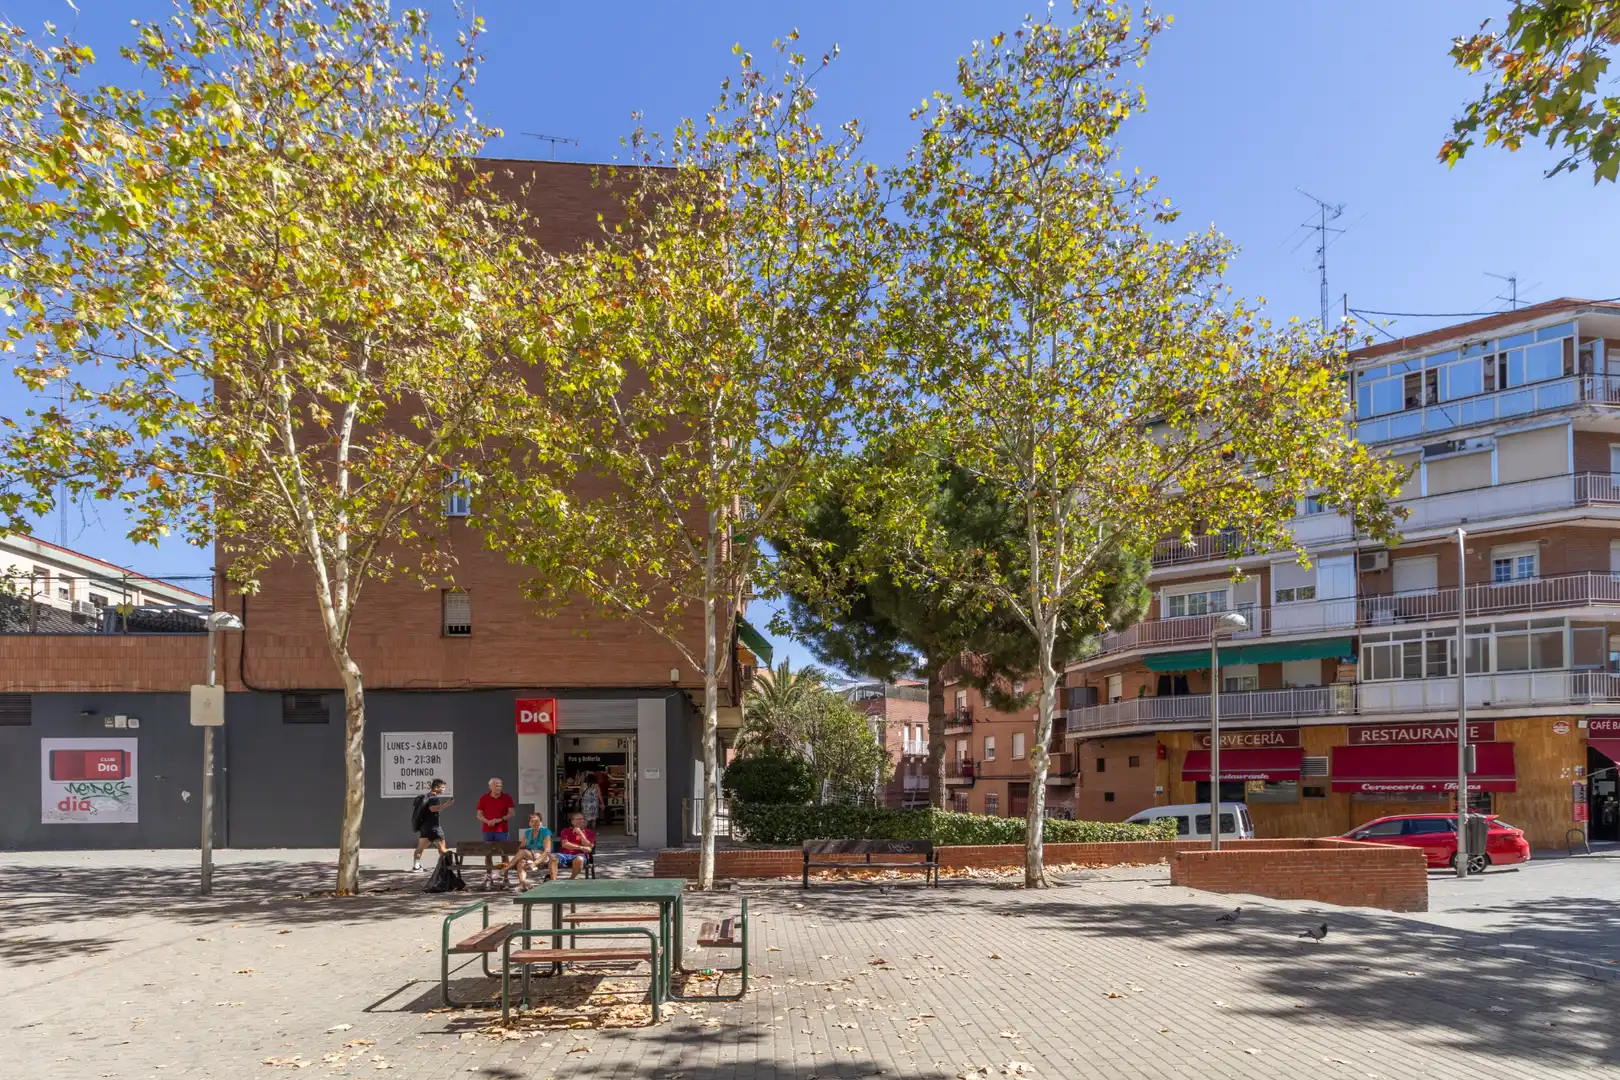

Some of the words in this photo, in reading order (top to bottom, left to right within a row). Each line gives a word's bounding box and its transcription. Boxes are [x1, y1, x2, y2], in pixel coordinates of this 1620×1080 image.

[1590, 720, 1611, 730] CAFÉ
[1361, 726, 1479, 741] RESTAURANE
[1202, 732, 1285, 747] CRVECERÍA
[386, 741, 411, 751] LUNES
[416, 740, 448, 751] SÁBADO
[393, 755, 405, 764] 9h
[414, 755, 442, 764] 21:30h
[400, 768, 434, 776] DOMINGO
[393, 781, 407, 790] 10h
[1443, 782, 1481, 790] Taas
